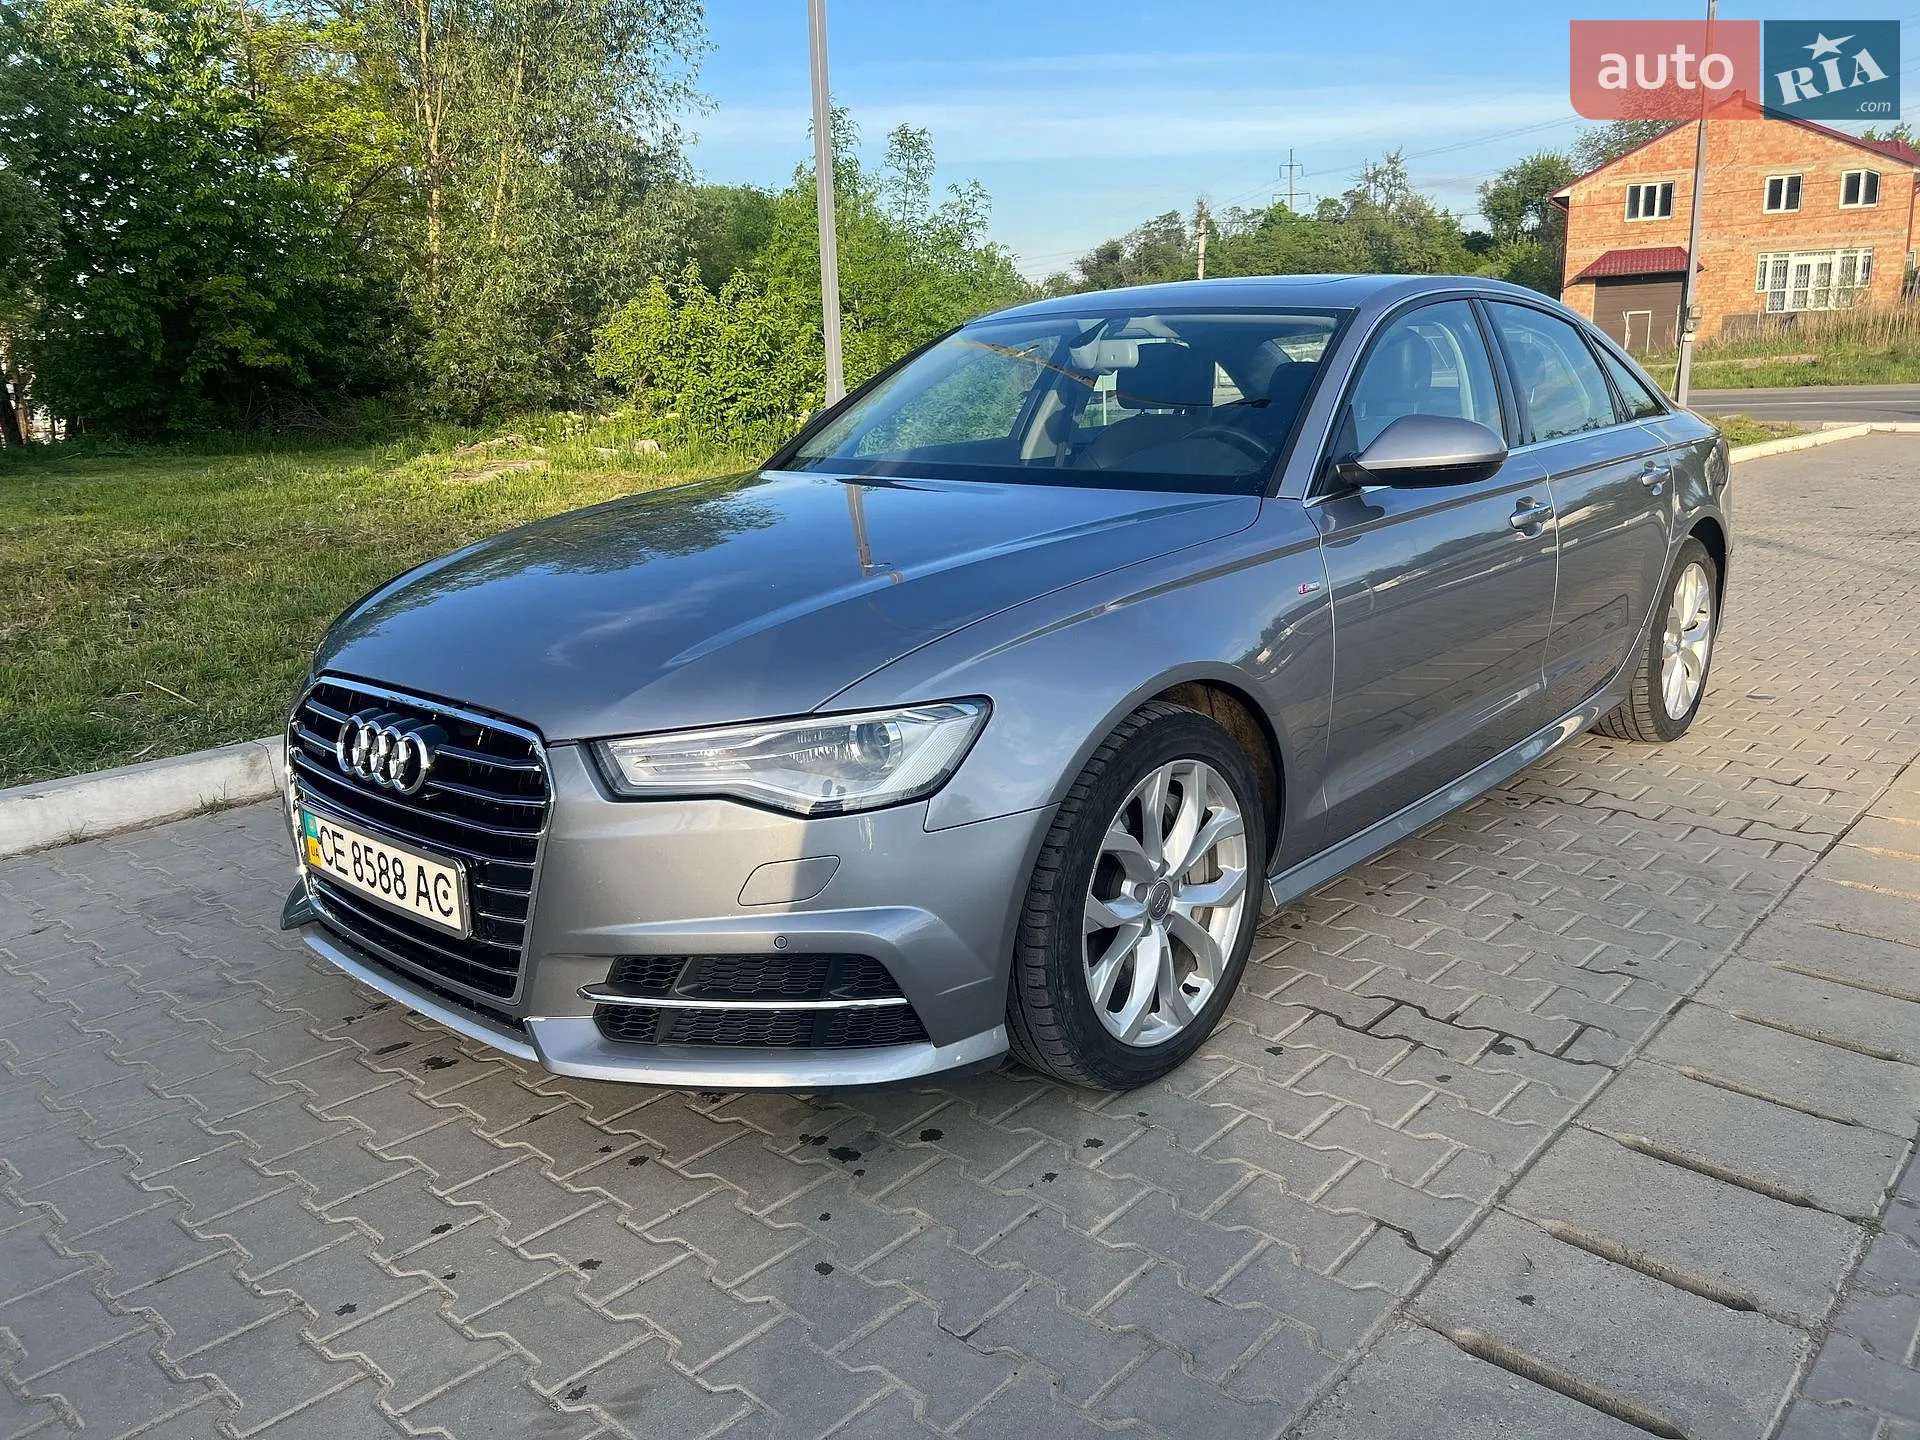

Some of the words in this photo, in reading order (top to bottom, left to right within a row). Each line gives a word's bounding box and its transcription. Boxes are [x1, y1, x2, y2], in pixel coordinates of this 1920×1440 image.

[310, 846, 320, 858] UA
[319, 826, 349, 876] CE
[352, 841, 407, 900] 8588
[416, 865, 454, 917] AC
